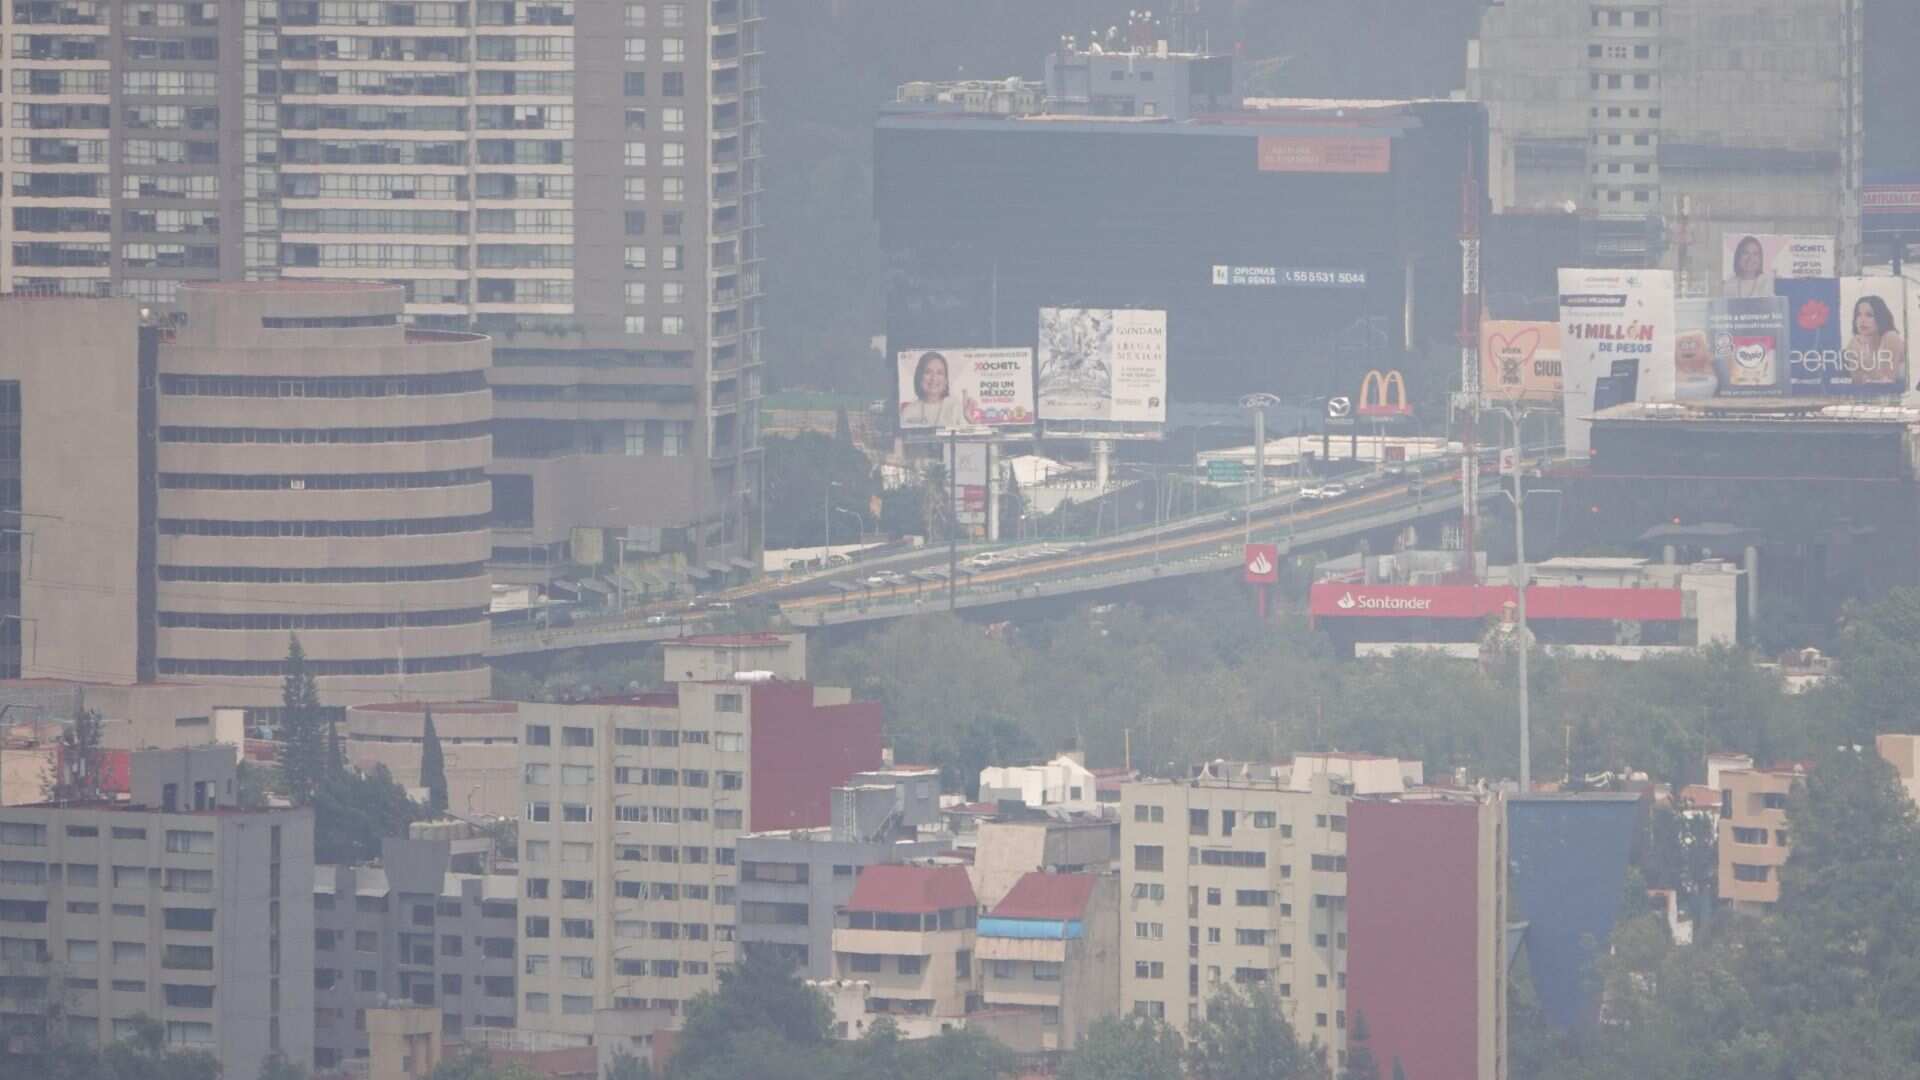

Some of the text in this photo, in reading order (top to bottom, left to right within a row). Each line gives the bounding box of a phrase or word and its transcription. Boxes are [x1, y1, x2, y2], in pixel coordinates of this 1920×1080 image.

[1233, 267, 1276, 276] OFICINAS
[1232, 276, 1277, 284] EN RENTA
[1568, 320, 1655, 340] $1 MILLÓN
[1599, 342, 1653, 353] DE PESOS
[1358, 595, 1432, 610] Santander
